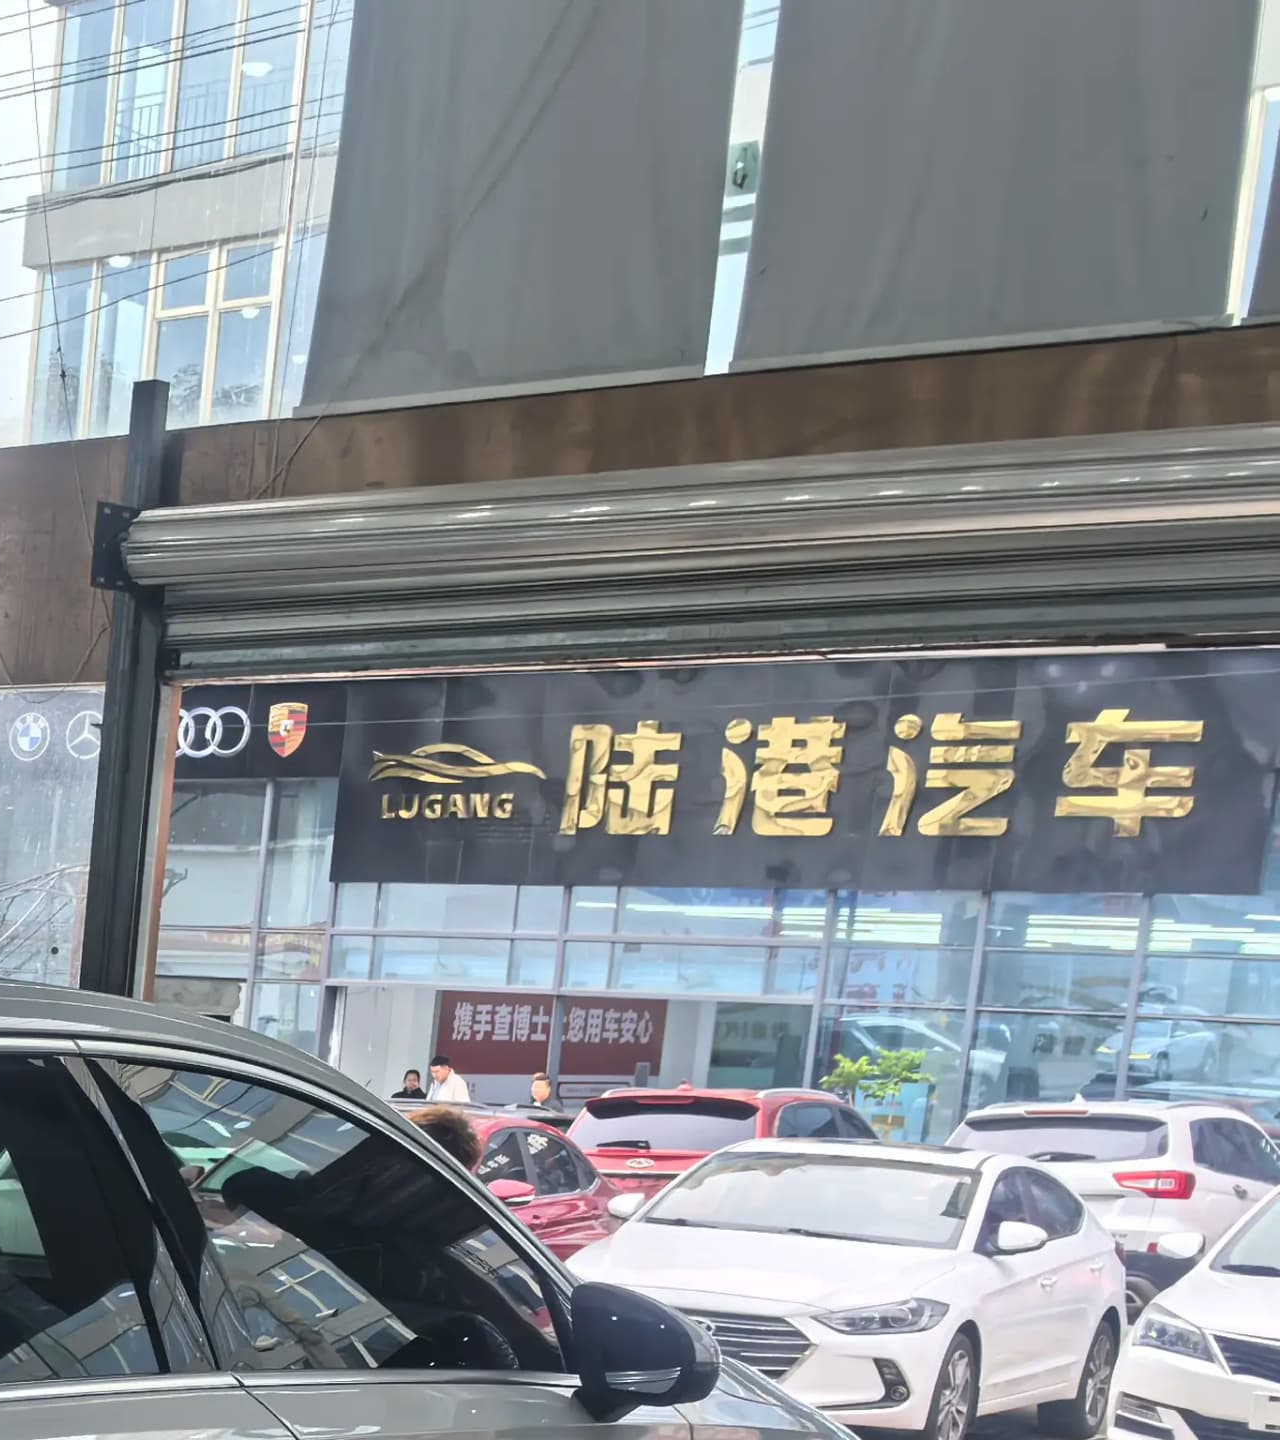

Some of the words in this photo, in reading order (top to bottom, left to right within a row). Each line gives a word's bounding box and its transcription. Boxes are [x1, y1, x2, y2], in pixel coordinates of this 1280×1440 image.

[559, 708, 1204, 838] 陆港汽车
[452, 1001, 654, 1044] 携手查博士您用车安心
